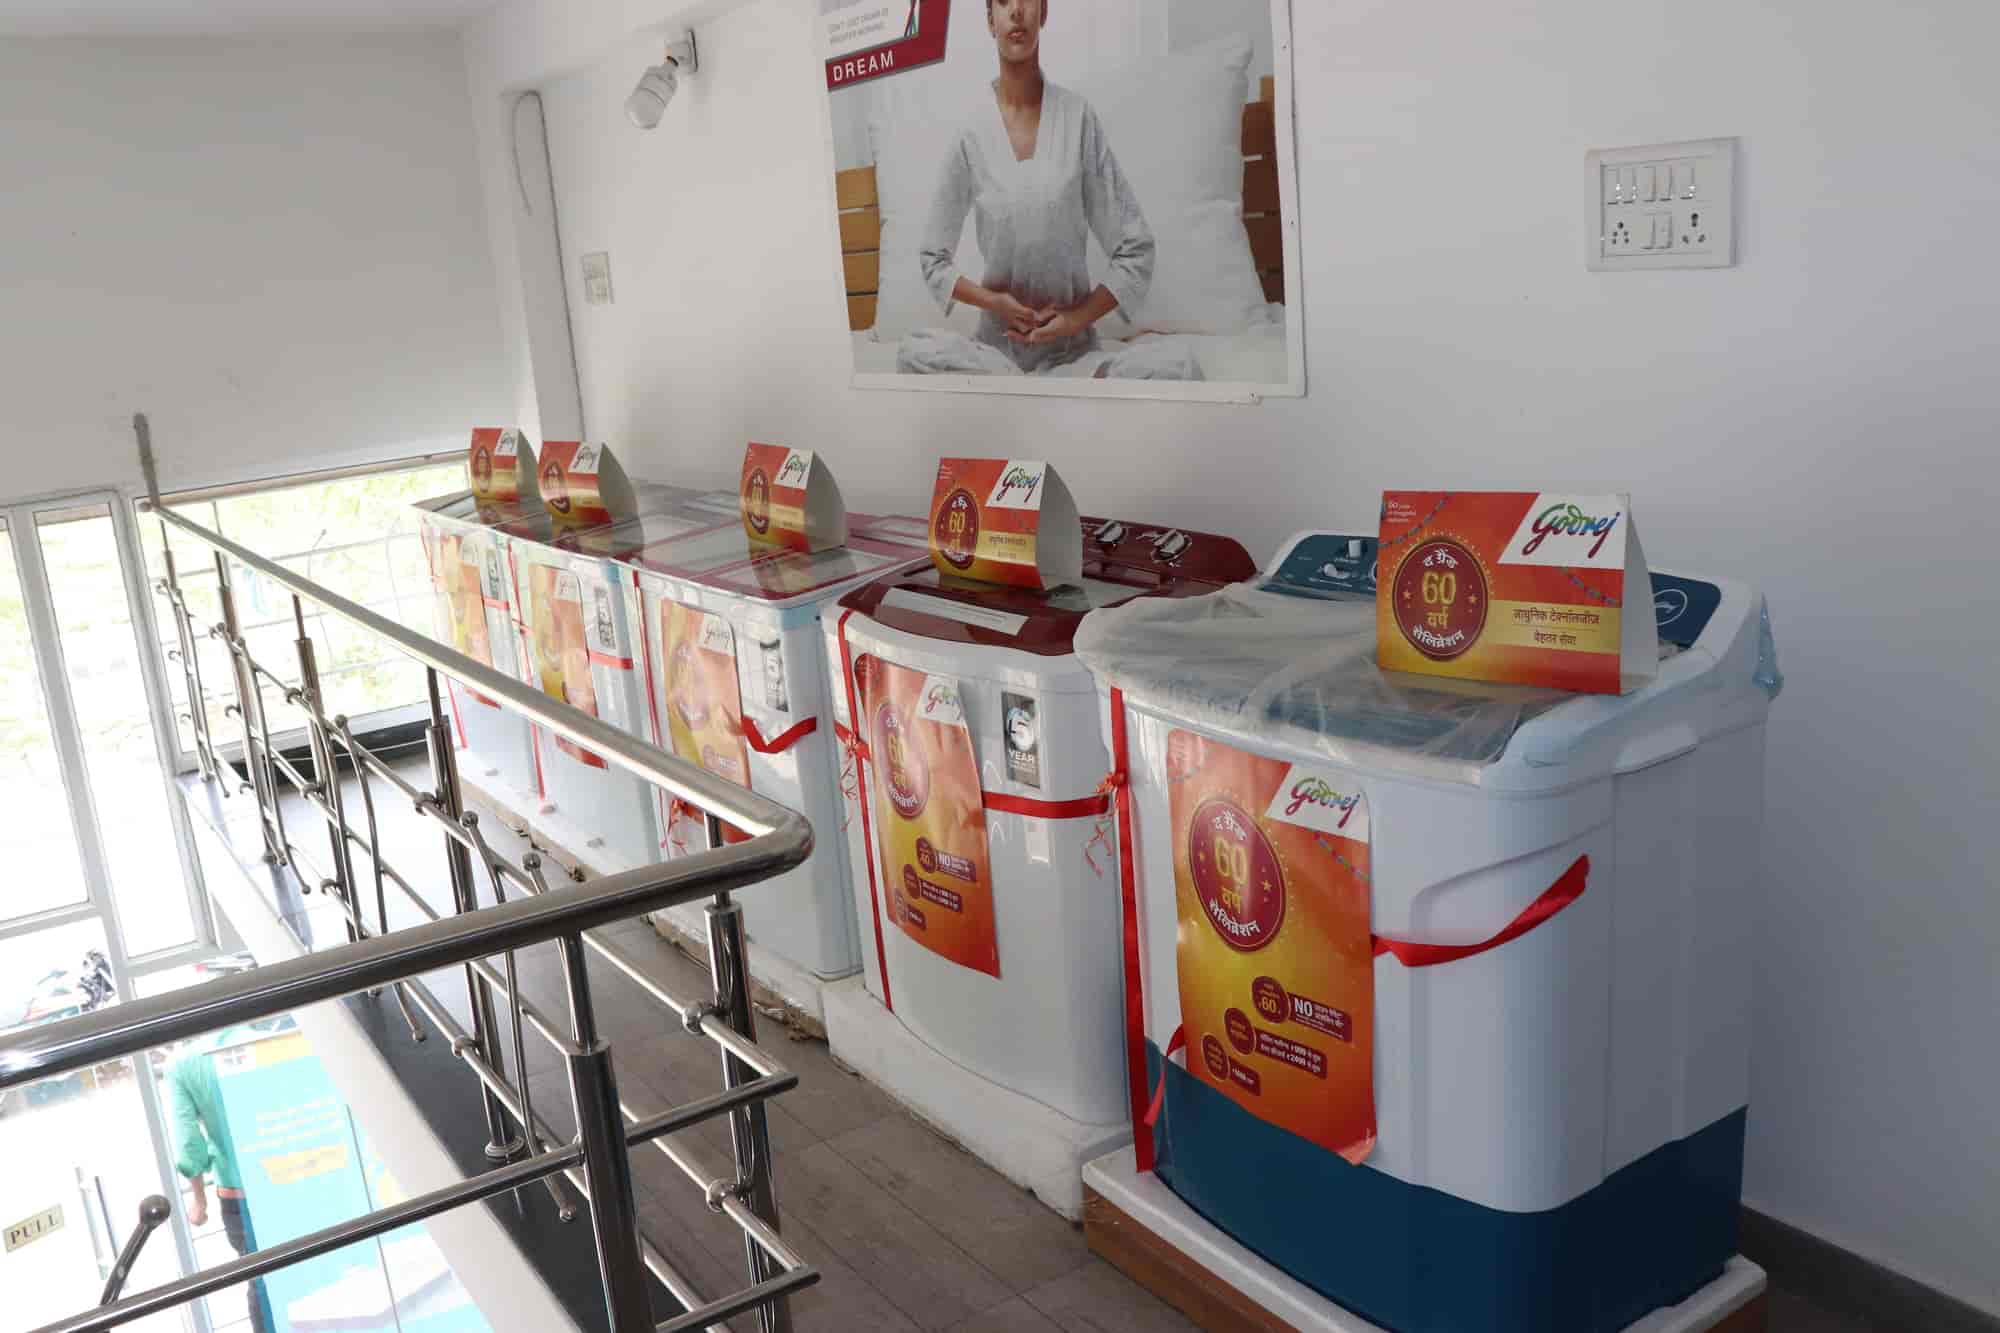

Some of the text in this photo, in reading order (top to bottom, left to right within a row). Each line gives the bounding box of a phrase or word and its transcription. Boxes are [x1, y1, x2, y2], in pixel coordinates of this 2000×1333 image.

[832, 50, 895, 81] DREAM
[995, 466, 1042, 503] Godrej
[949, 511, 965, 533] 60
[1522, 503, 1620, 558] Godrej
[1423, 571, 1456, 606] 60
[1009, 749, 1034, 764] YEAR
[1285, 777, 1360, 828] Godrej
[1214, 835, 1248, 885] 60
[1261, 997, 1276, 1013] 60
[1294, 998, 1313, 1017] NO
[11, 1214, 59, 1244] PULL
